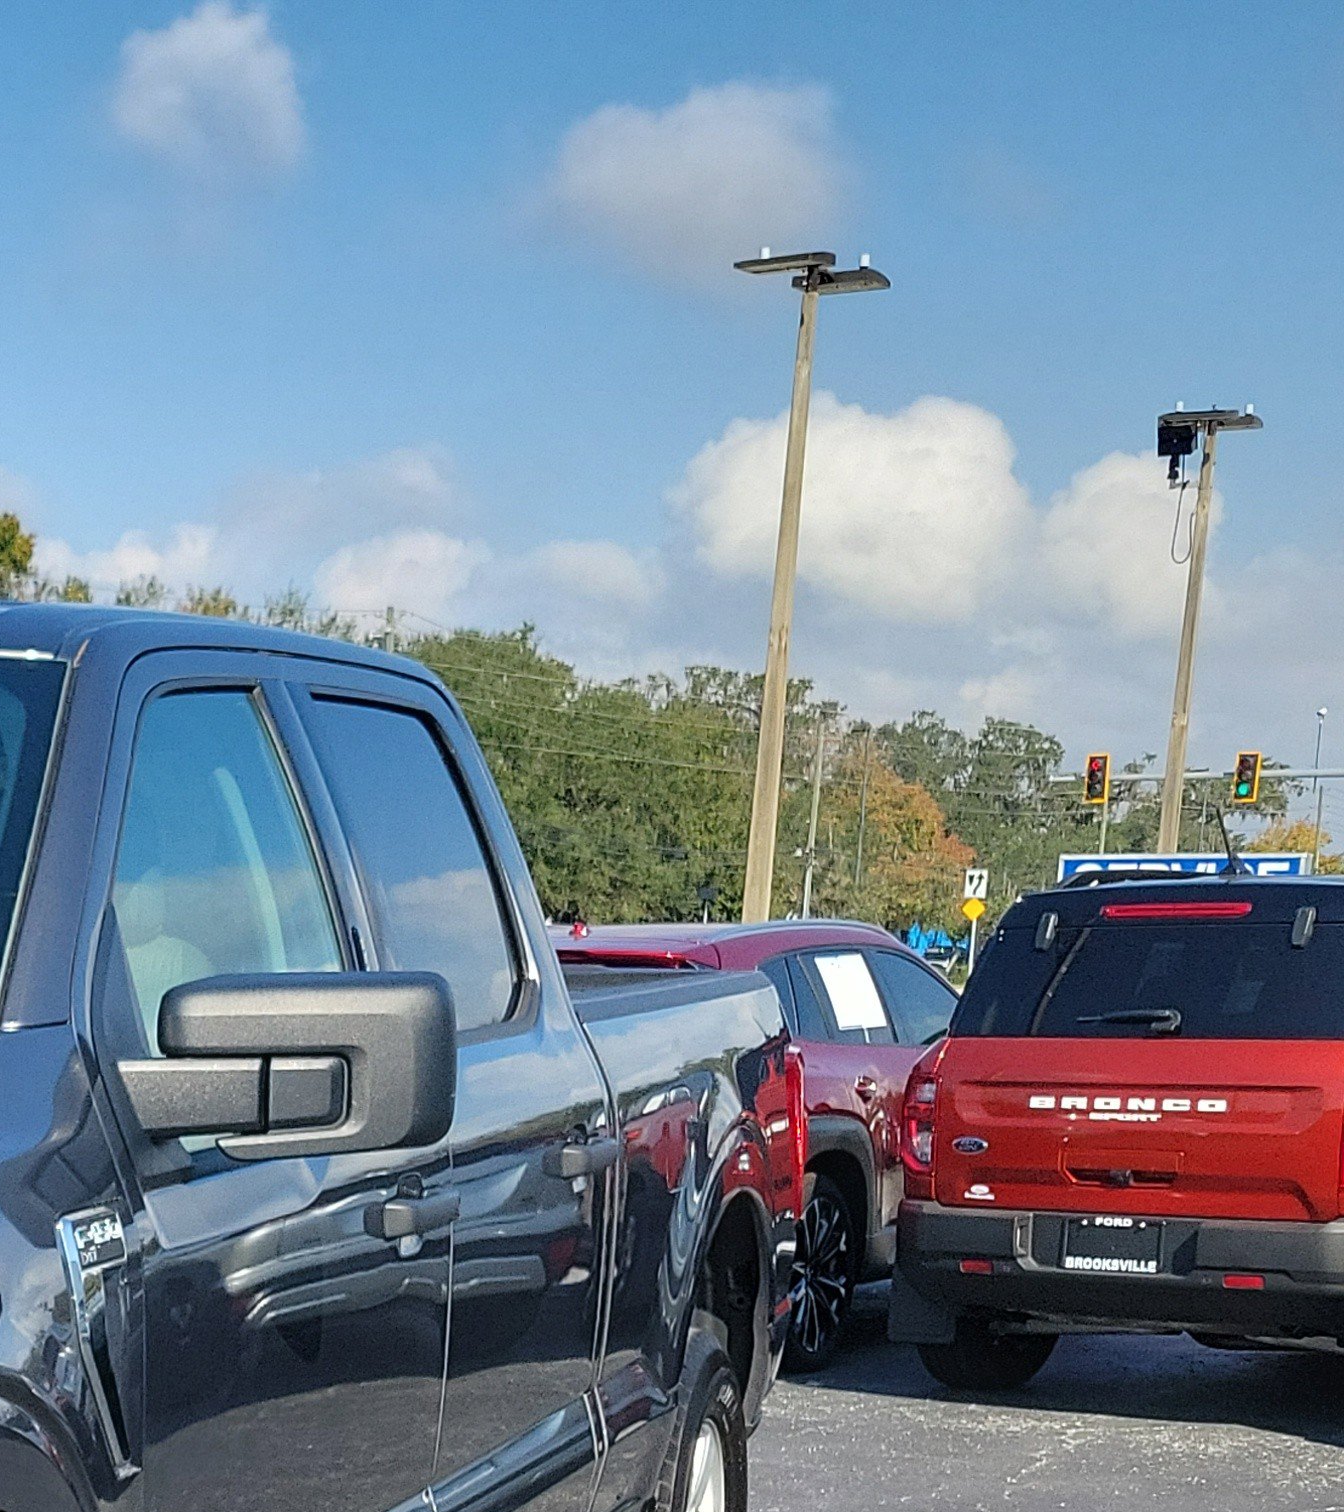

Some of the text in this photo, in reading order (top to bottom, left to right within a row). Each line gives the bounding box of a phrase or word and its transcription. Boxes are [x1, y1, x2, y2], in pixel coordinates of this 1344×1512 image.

[1029, 1096, 1227, 1112] BRONCO
[1088, 1111, 1162, 1122] SPORT
[1094, 1217, 1133, 1228] FORD
[1064, 1256, 1157, 1274] BROOKSVILLE
